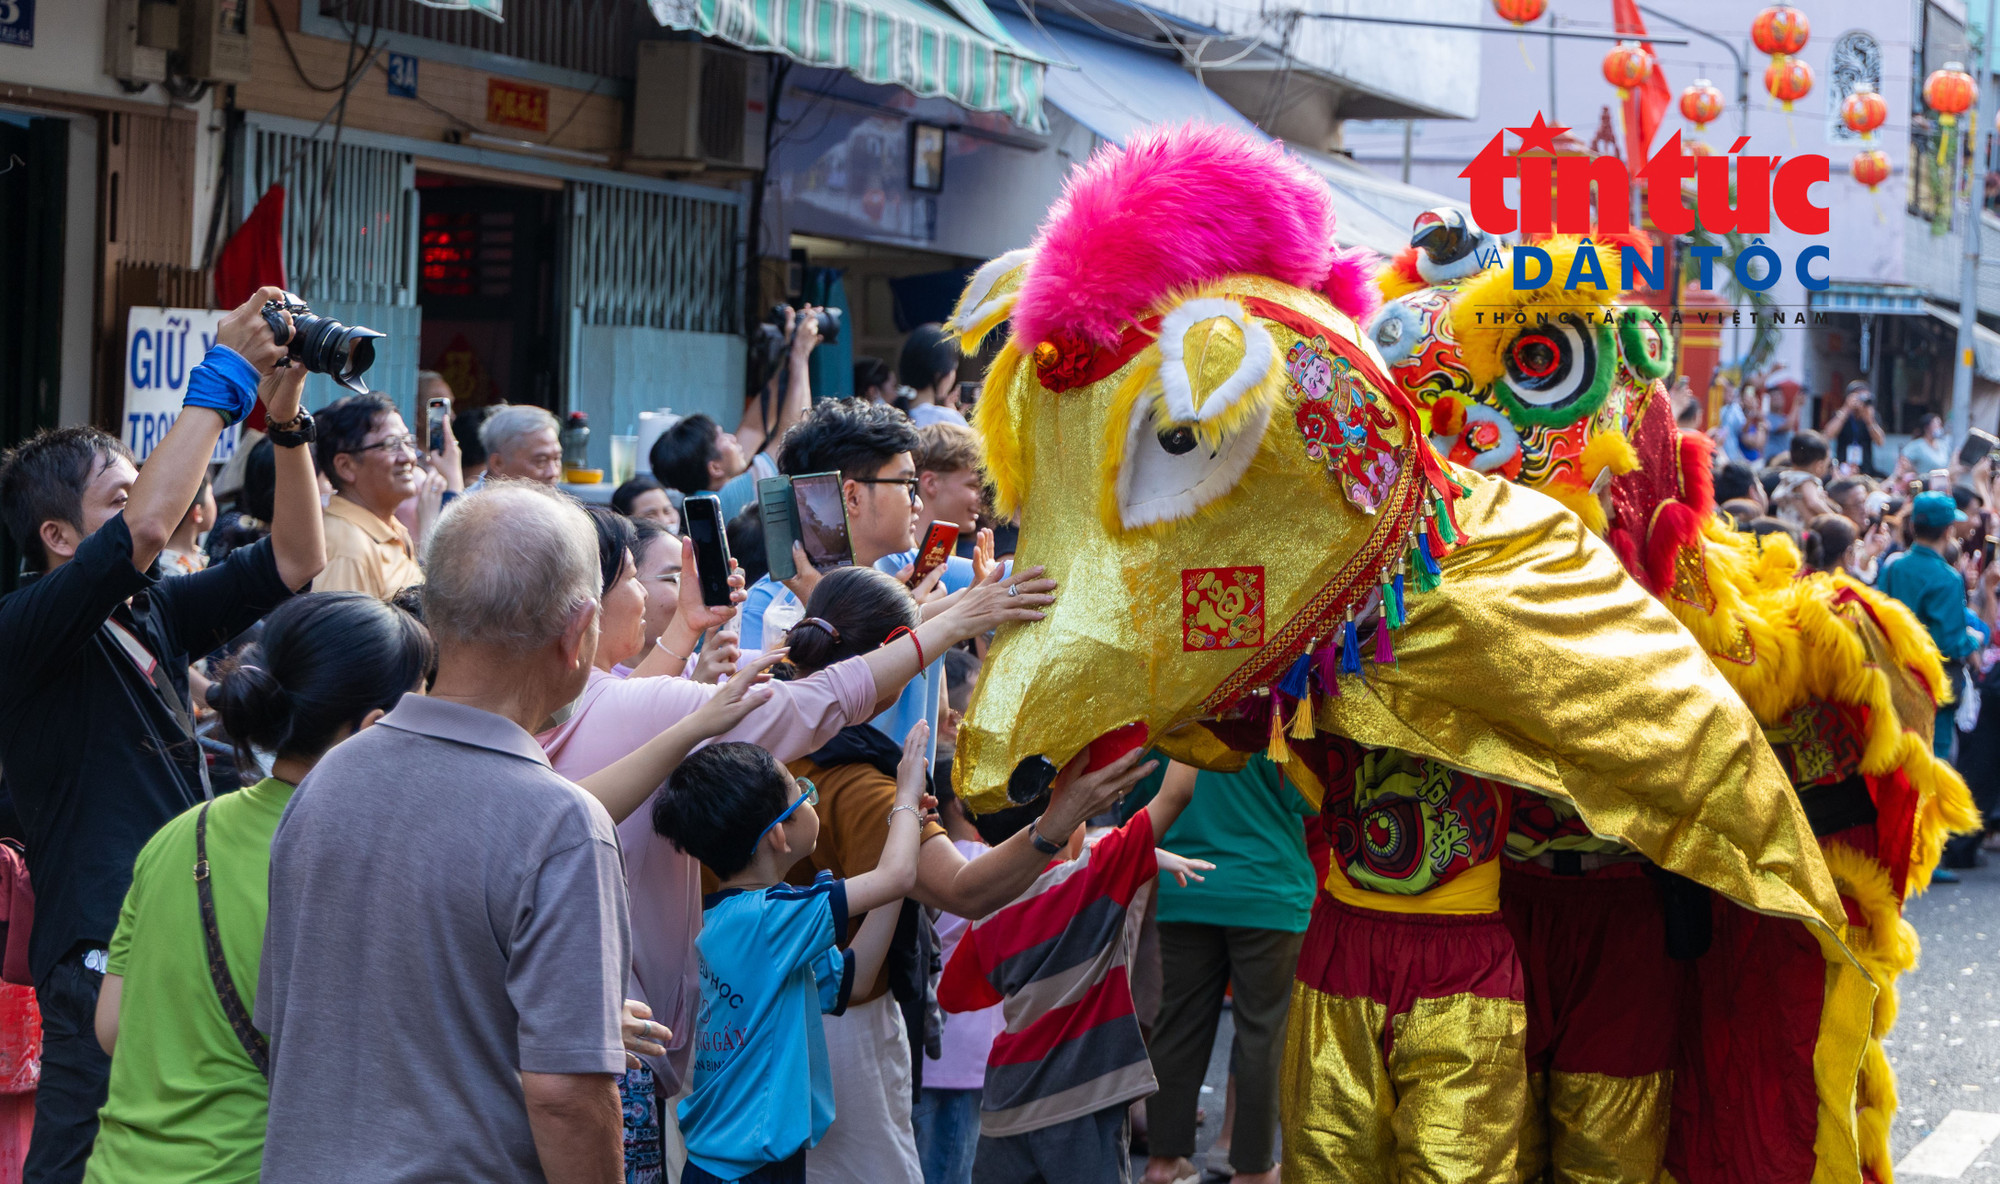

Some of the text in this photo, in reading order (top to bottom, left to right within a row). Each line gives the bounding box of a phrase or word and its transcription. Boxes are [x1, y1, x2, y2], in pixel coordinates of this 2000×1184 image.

[391, 56, 416, 88] 3A
[131, 316, 190, 390] GIỮ
[710, 972, 744, 1009] HỌC
